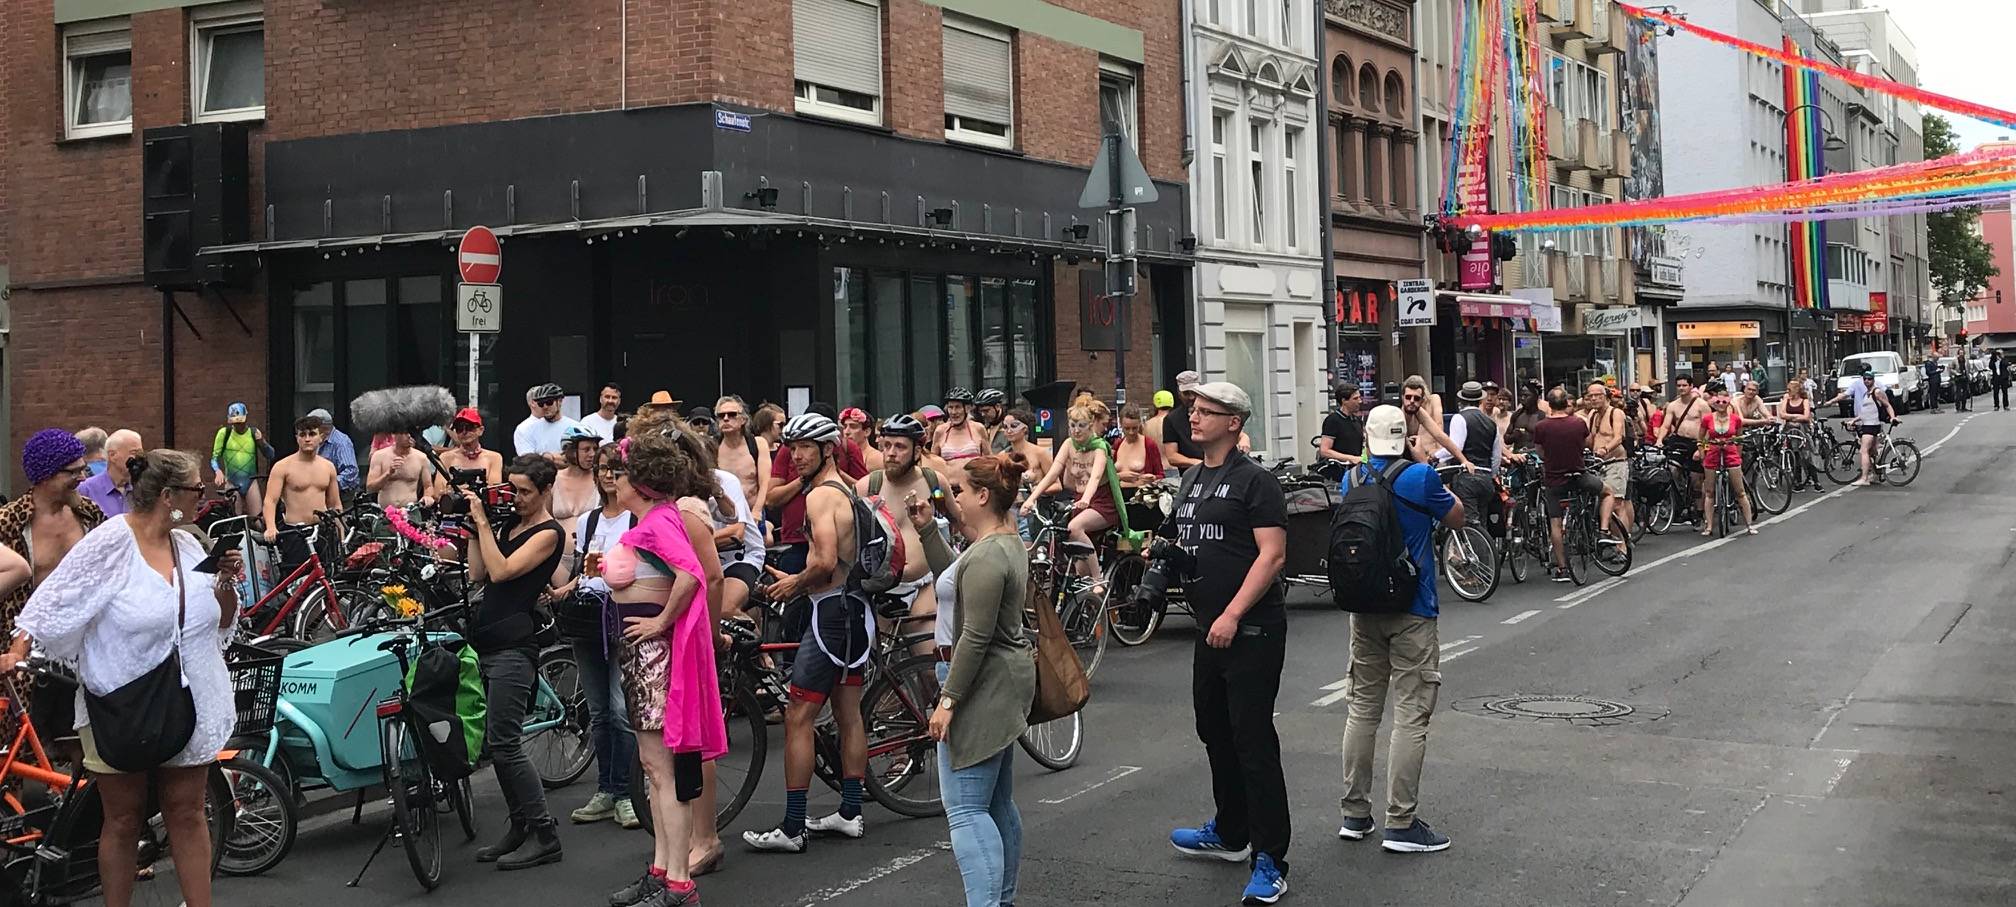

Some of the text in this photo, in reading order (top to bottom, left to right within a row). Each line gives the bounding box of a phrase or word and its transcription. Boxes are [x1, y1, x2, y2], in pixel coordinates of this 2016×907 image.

[1335, 290, 1379, 325] BAR
[472, 315, 487, 326] frei
[1199, 523, 1224, 540] YOU
